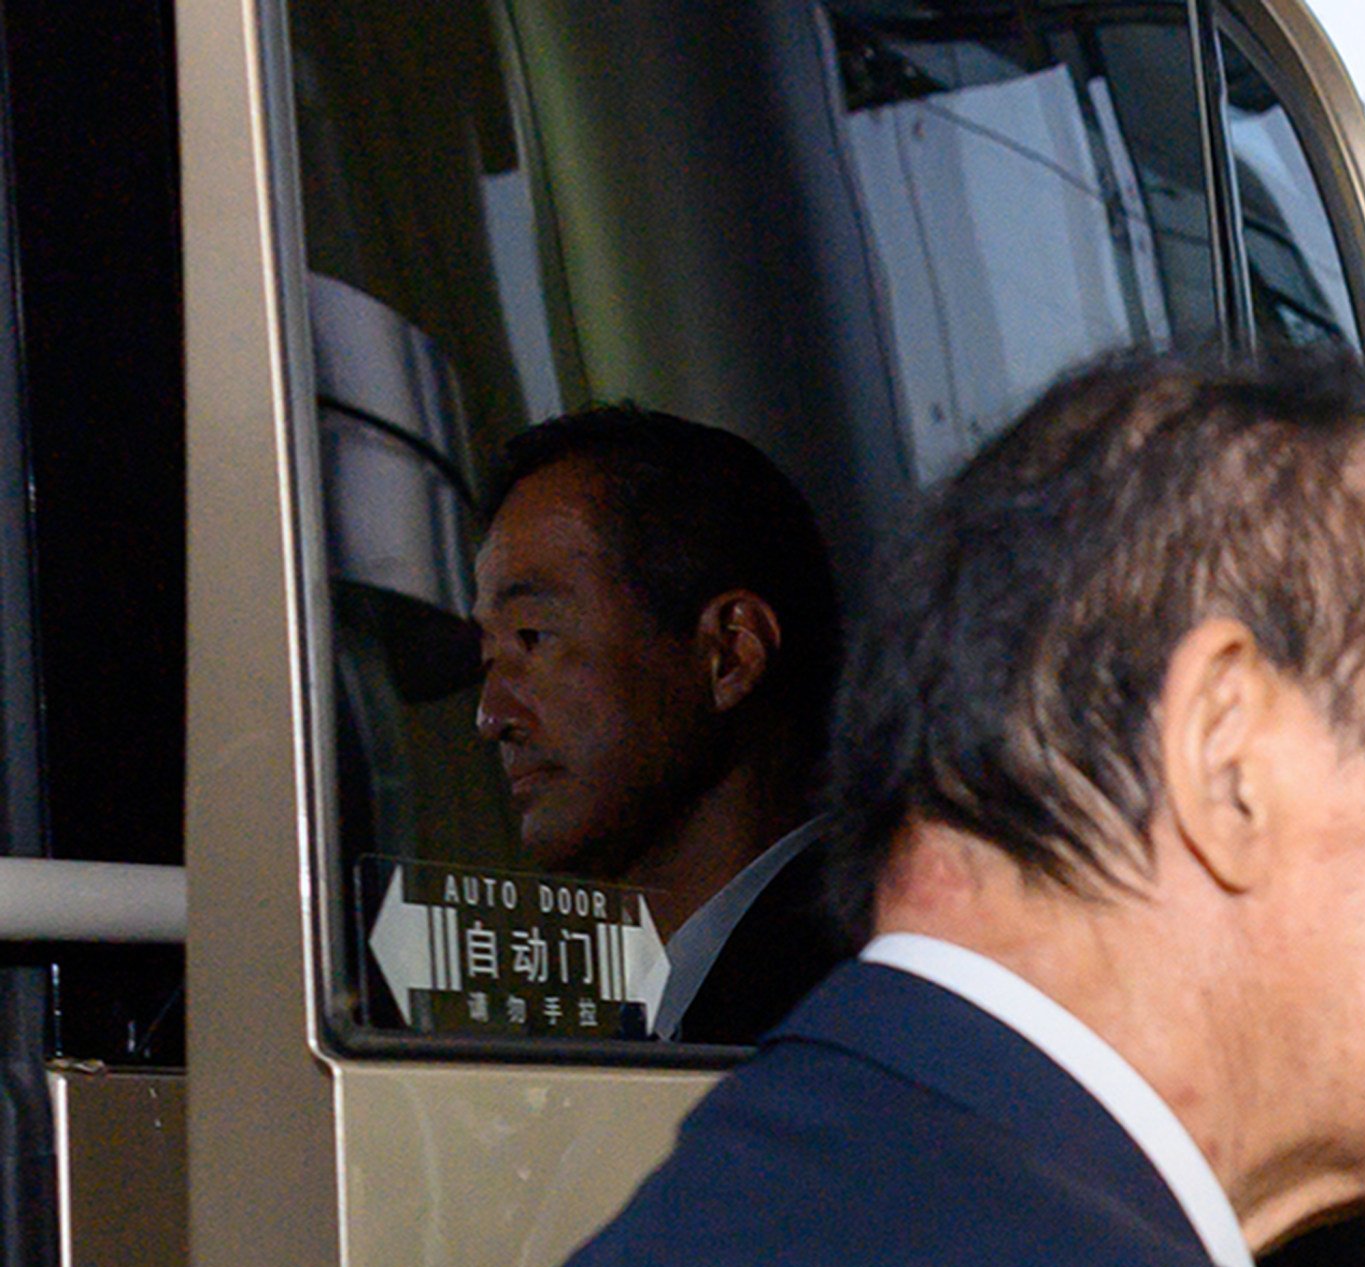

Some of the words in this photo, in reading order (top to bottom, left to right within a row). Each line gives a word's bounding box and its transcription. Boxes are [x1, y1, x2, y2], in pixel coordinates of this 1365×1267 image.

[445, 874, 517, 909] AUTO
[539, 886, 608, 919] DOOR
[466, 920, 594, 985] 自动门
